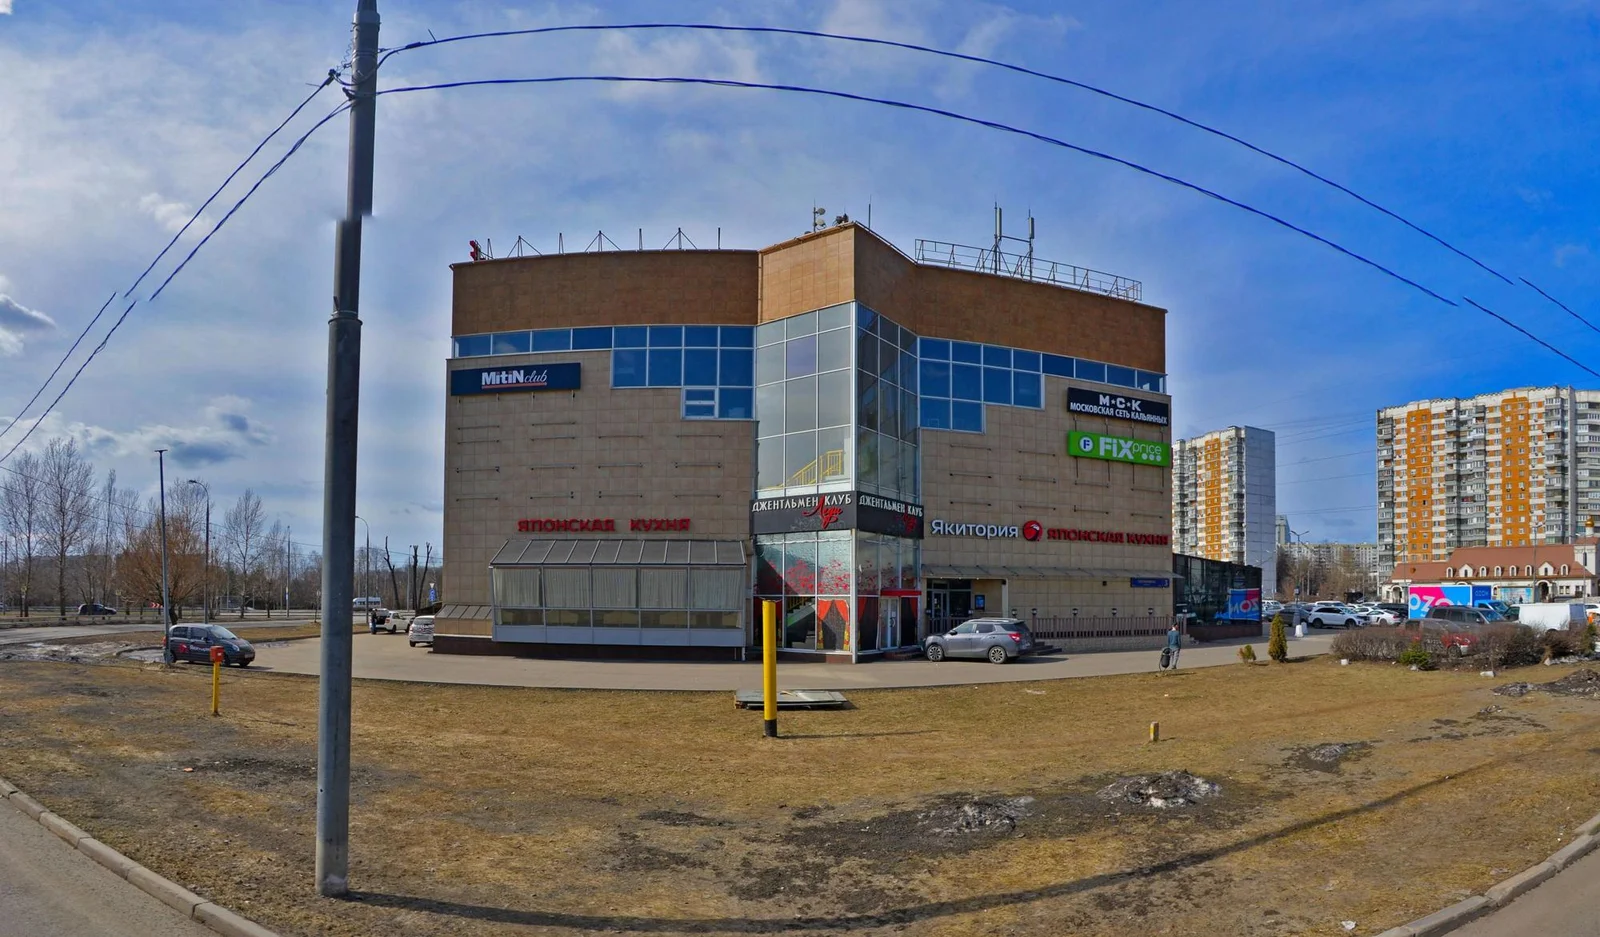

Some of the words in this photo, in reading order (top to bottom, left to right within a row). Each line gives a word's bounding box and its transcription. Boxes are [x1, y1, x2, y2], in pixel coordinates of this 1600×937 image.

[482, 370, 524, 386] MitiN
[524, 370, 548, 383] club
[1070, 402, 1114, 416] МОСКОВСКАЯ
[1115, 409, 1131, 419] СЕТЬ
[1130, 411, 1168, 425] КАЛЬЯННЫХ
[751, 496, 819, 512] ДЖЕНТЛЬМЕН
[825, 493, 852, 507] КЛУБ
[858, 495, 906, 513] ДЖЕНТЛЬМЕН
[907, 506, 923, 518] КЛУБ
[517, 518, 616, 533] ЯПОНСКАЯ
[629, 518, 692, 532] КУХНЯ
[931, 519, 1019, 540] Якитория
[1047, 527, 1124, 544] ЯПОНСКАЯ
[1126, 532, 1169, 546] КУХНЯ
[1410, 593, 1471, 612] OZ
